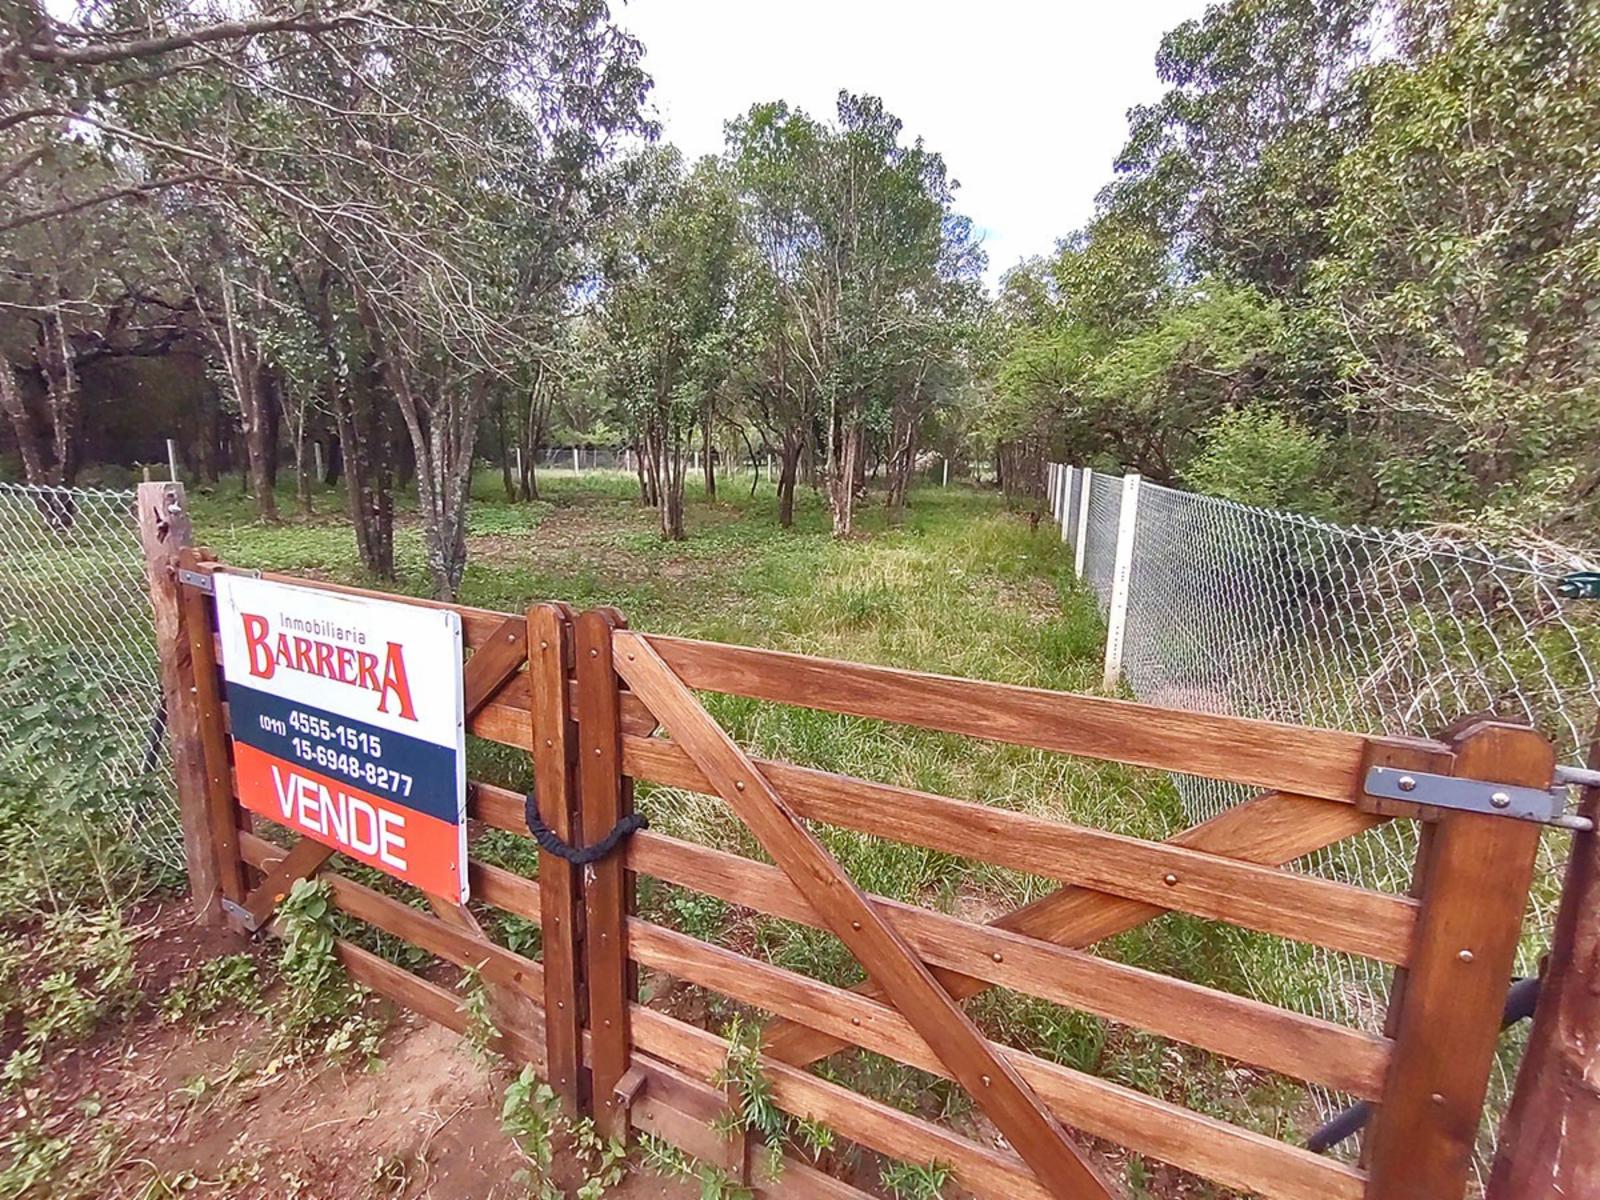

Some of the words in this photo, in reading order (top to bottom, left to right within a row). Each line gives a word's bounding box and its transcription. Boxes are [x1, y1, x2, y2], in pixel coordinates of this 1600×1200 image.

[280, 612, 367, 645] Inmobiliaria
[240, 612, 419, 722] BARRERA
[259, 714, 286, 736] (011)
[288, 709, 382, 758] 4555-1515
[292, 737, 413, 797] 15-6948-8277
[271, 765, 408, 871] VENDE
